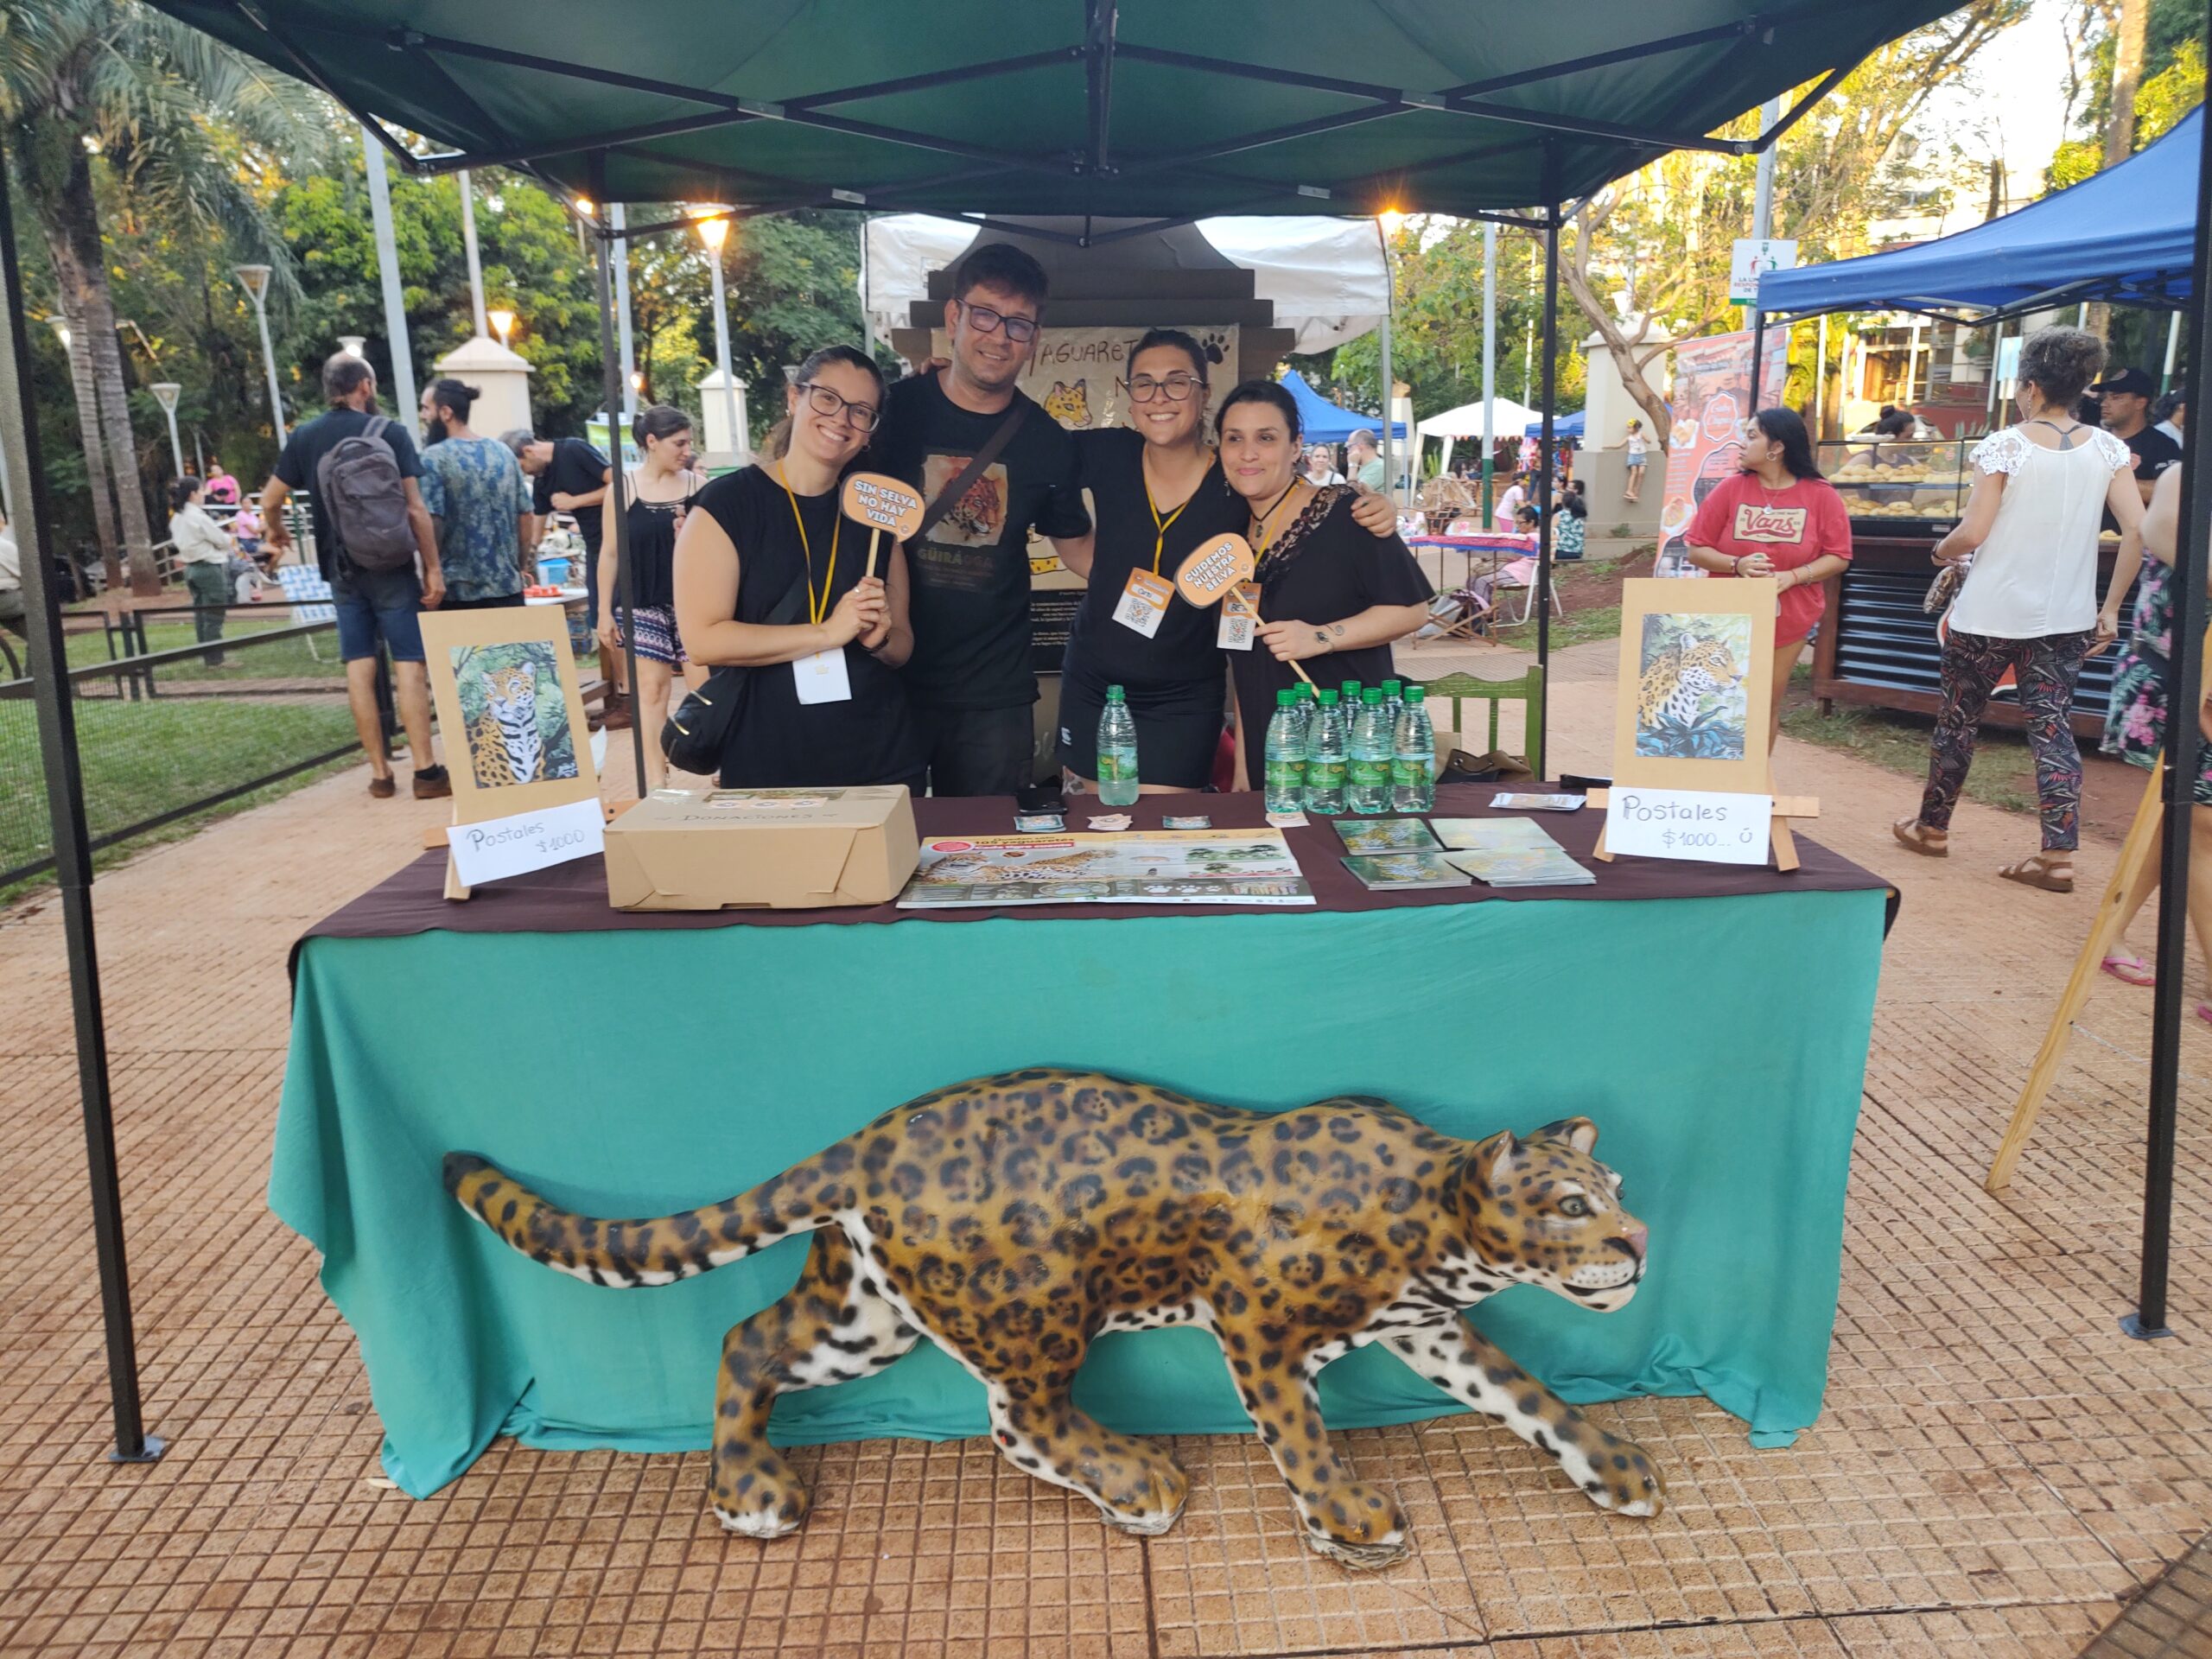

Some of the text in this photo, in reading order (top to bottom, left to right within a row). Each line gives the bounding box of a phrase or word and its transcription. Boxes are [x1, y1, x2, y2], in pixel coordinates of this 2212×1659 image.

[855, 479, 918, 510] SIN SELVA
[858, 493, 907, 517] NO HAY
[866, 507, 897, 527] VIDA
[1743, 508, 1796, 537] Vans
[1185, 541, 1233, 582] CUIDEMOS
[1193, 553, 1237, 588] NUESTRA
[1205, 566, 1237, 591] SELVA
[1622, 795, 1728, 821] Postales
[466, 822, 546, 853] Postales
[535, 829, 586, 853] $1000
